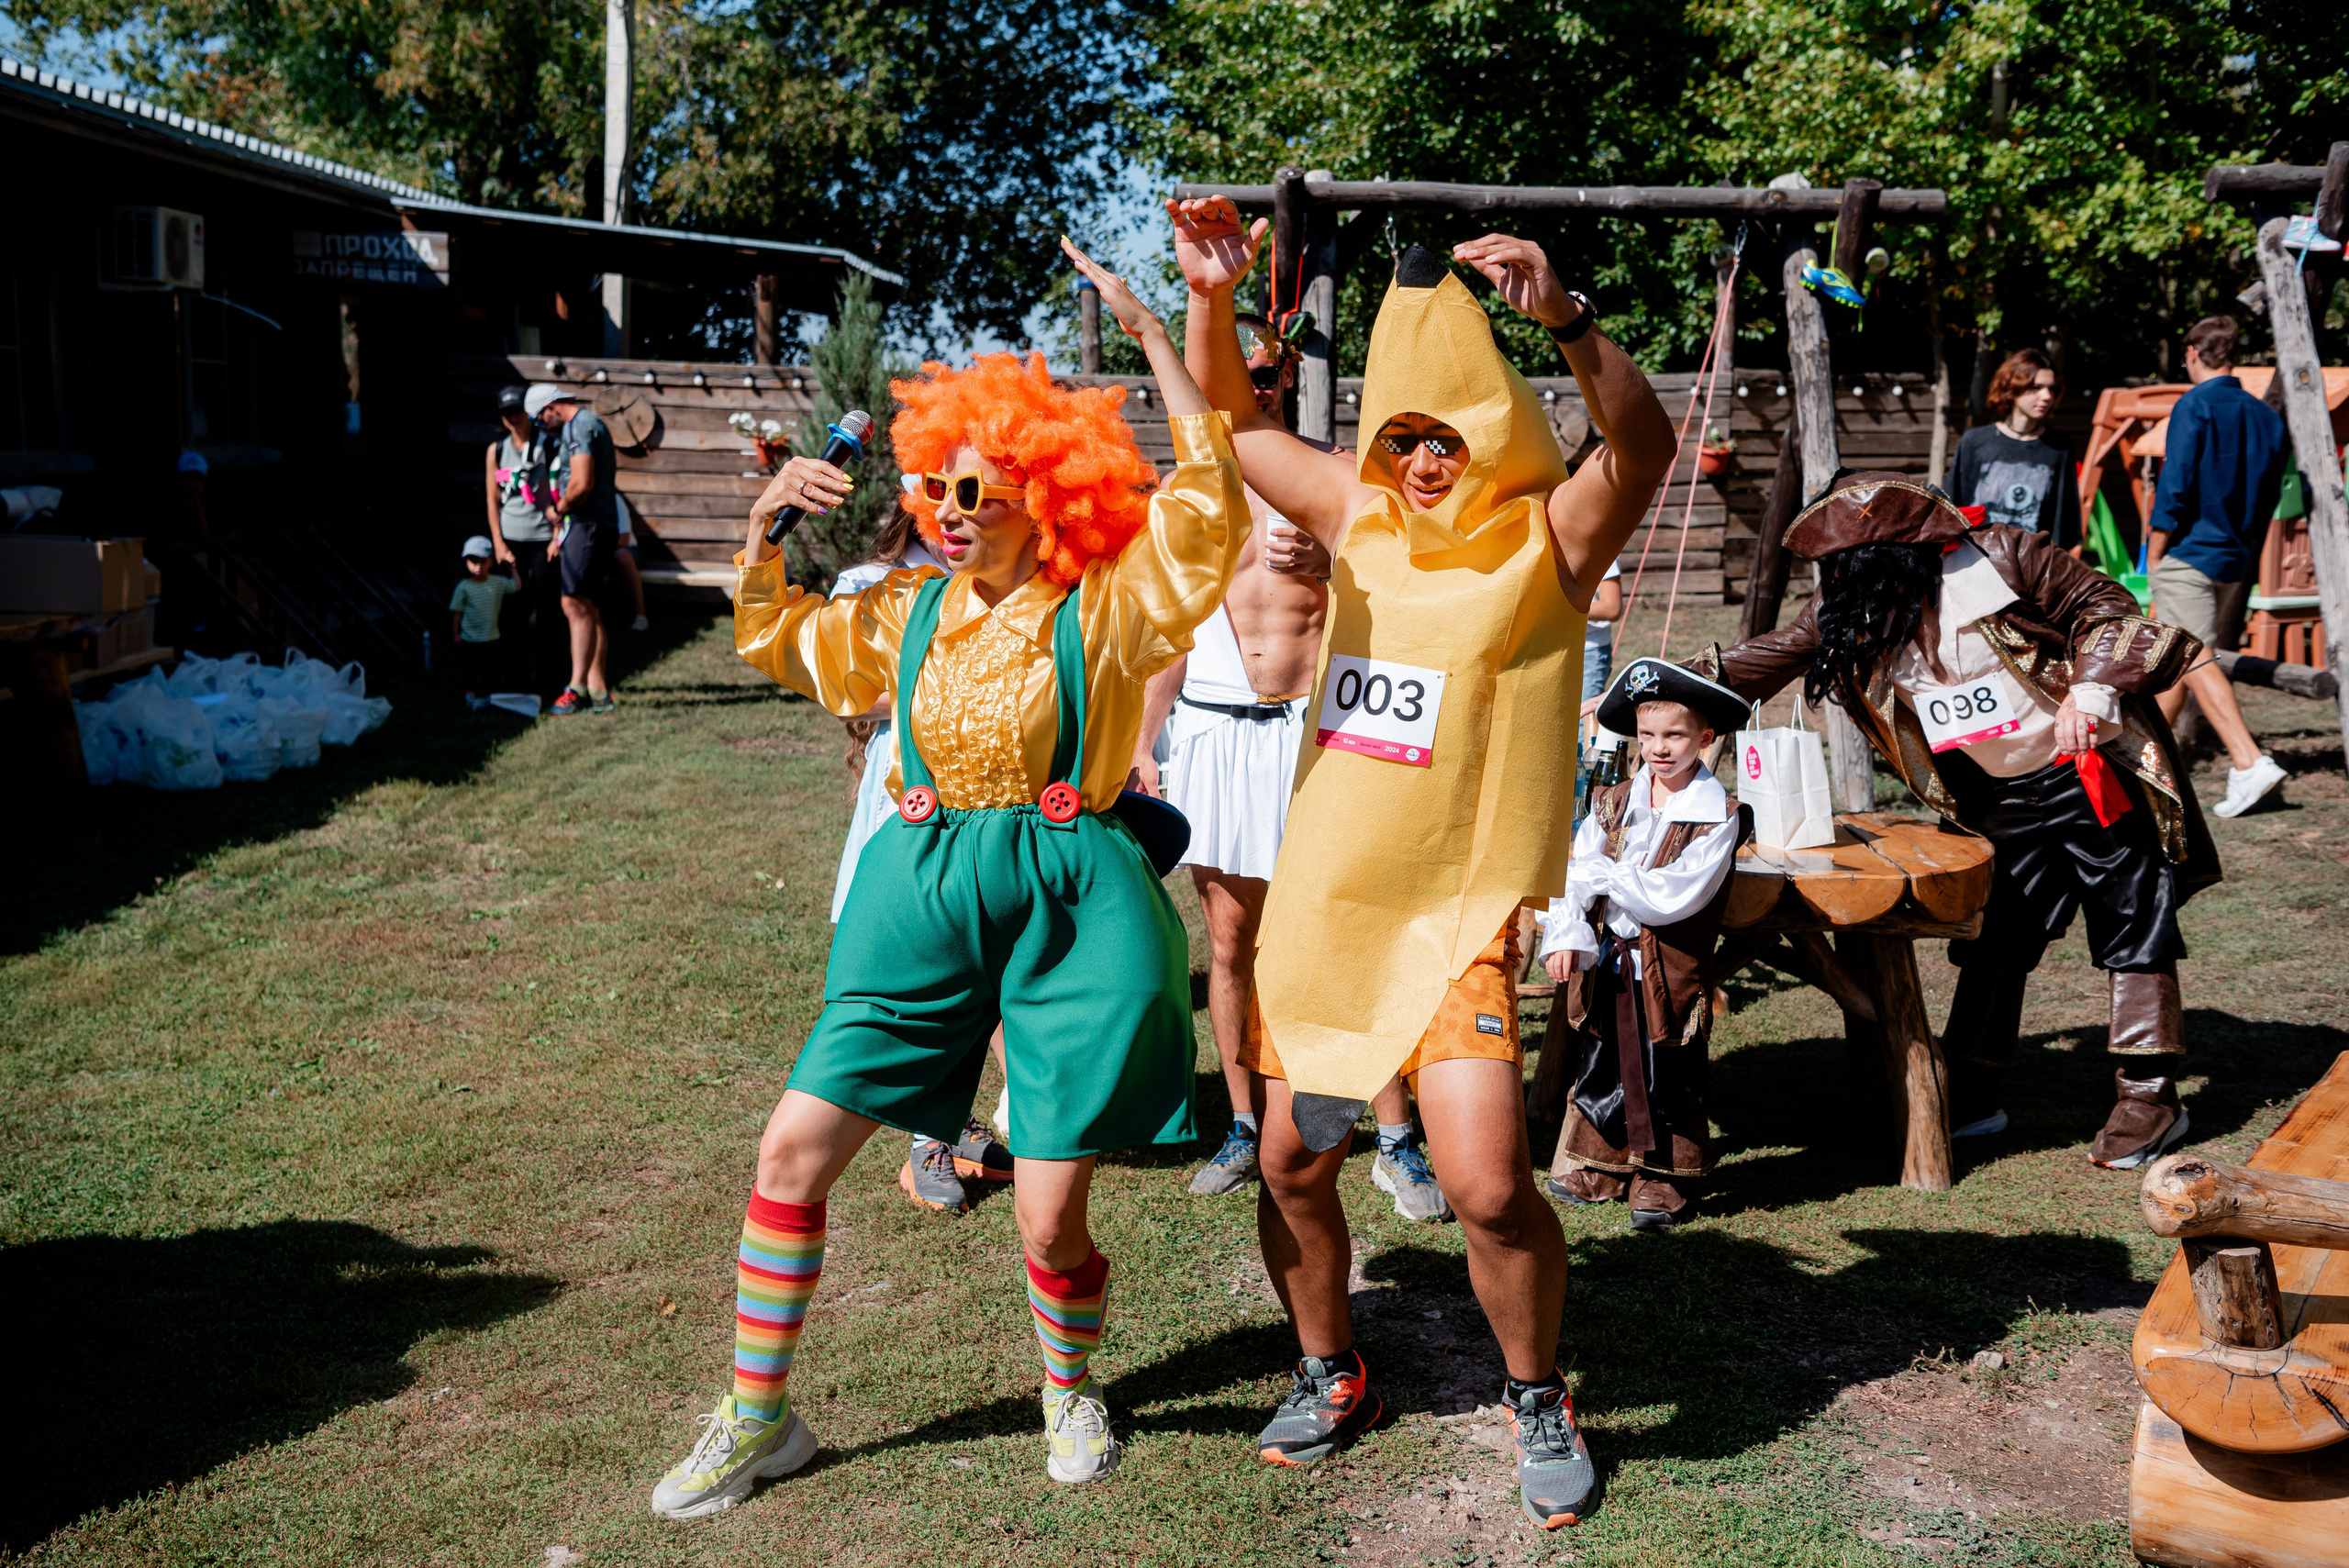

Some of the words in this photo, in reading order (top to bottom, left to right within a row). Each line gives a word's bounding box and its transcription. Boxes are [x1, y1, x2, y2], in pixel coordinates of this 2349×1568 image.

[325, 234, 439, 267] ПРОХОД
[294, 261, 418, 284] ЗАПРЕЩЕН
[1336, 669, 1425, 722] 003
[1930, 686, 1998, 726] 098
[1385, 745, 1399, 753] 2024
